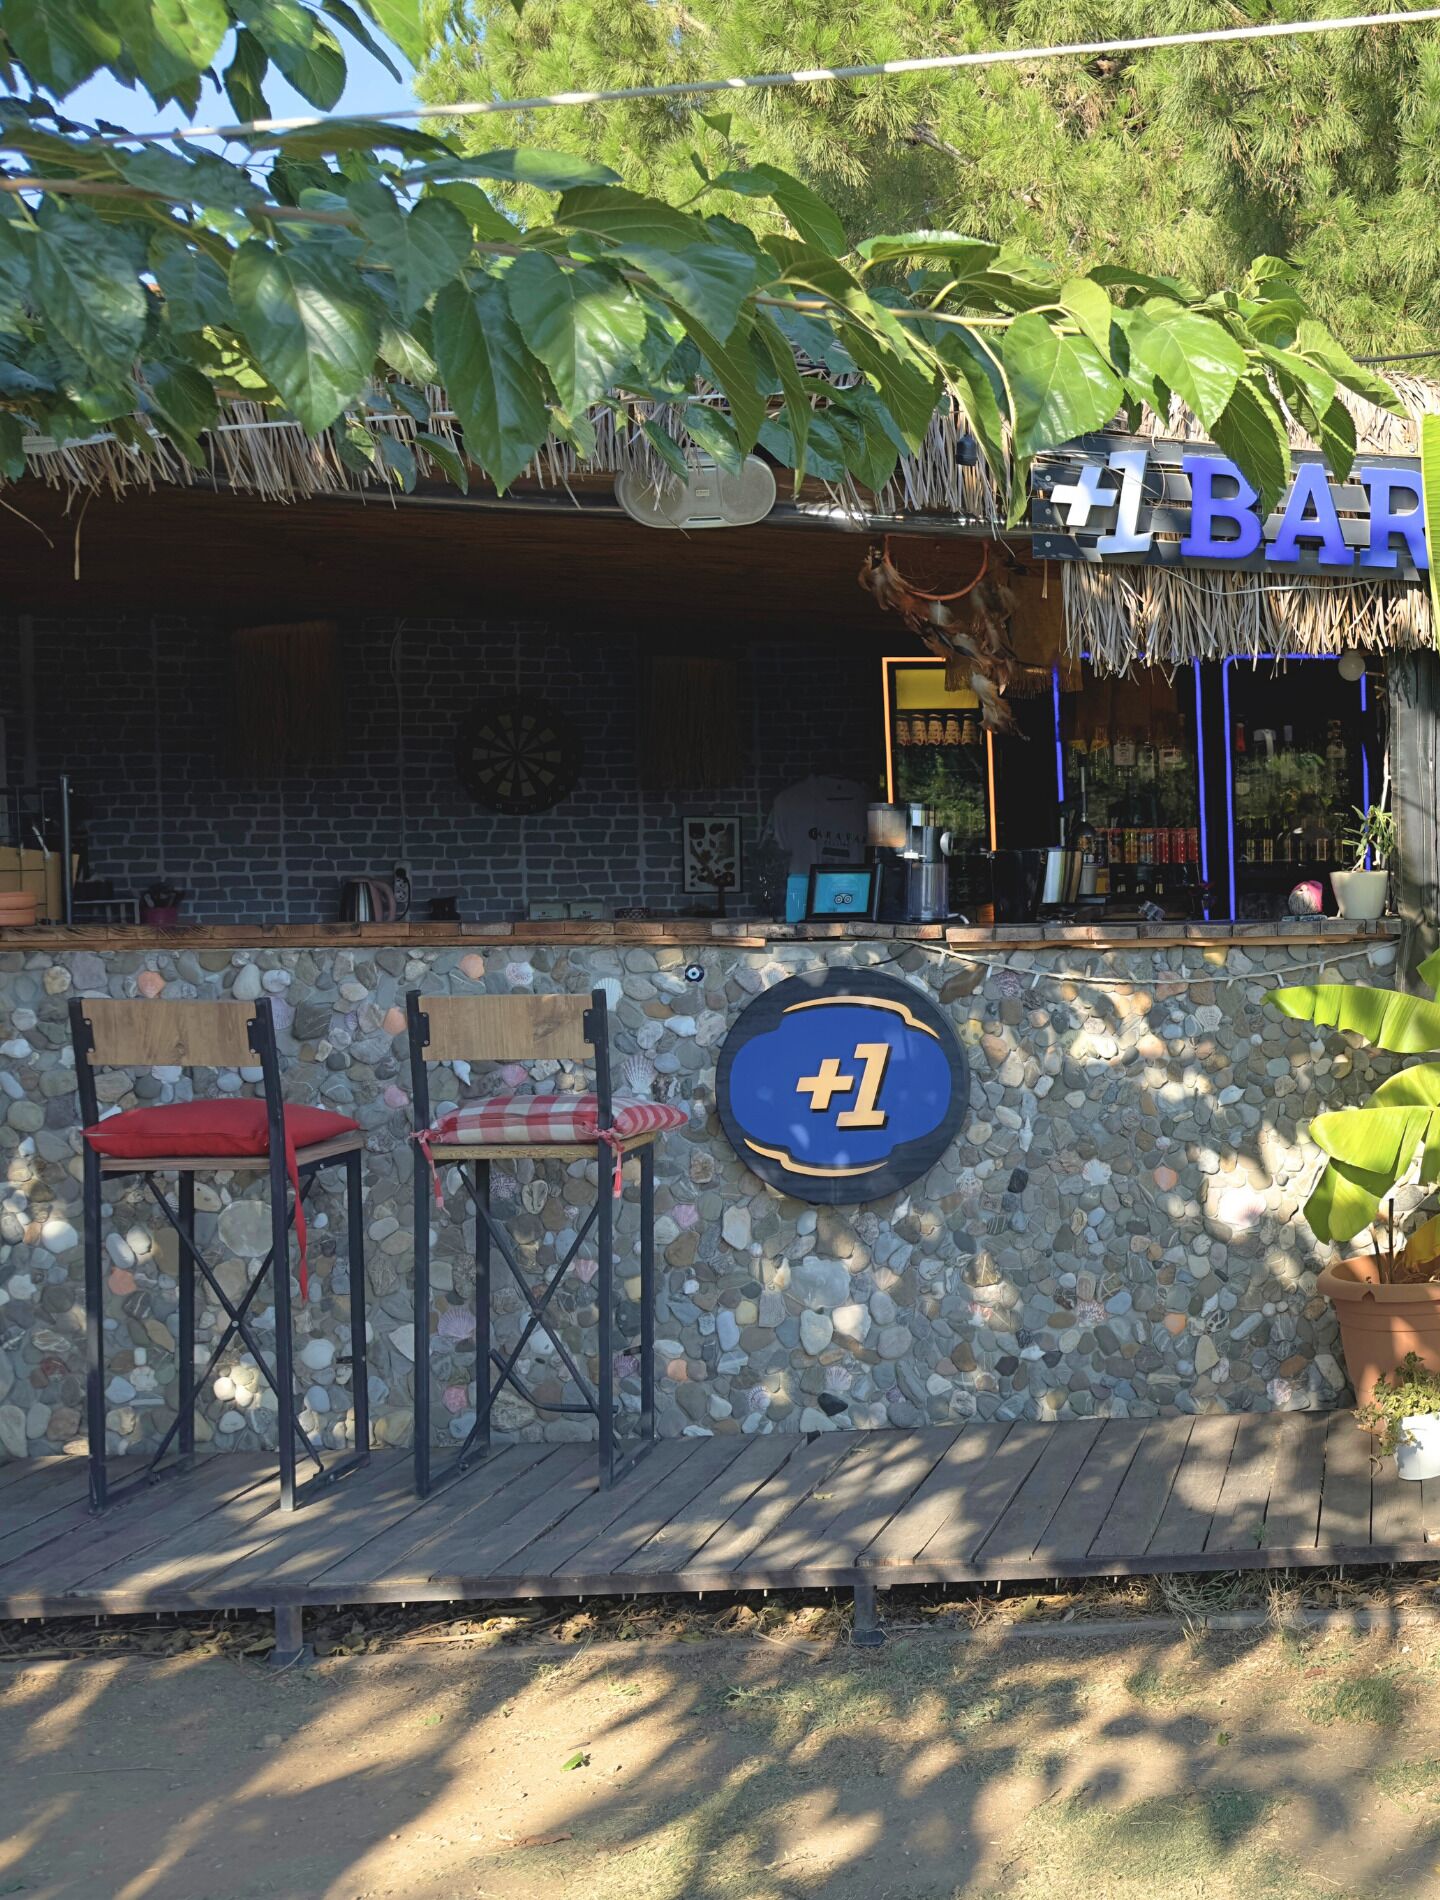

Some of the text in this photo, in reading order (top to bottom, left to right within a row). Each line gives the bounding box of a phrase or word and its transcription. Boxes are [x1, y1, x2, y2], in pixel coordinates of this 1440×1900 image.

[1050, 450, 1430, 569] +1 BAR
[796, 1043, 889, 1128] +1
